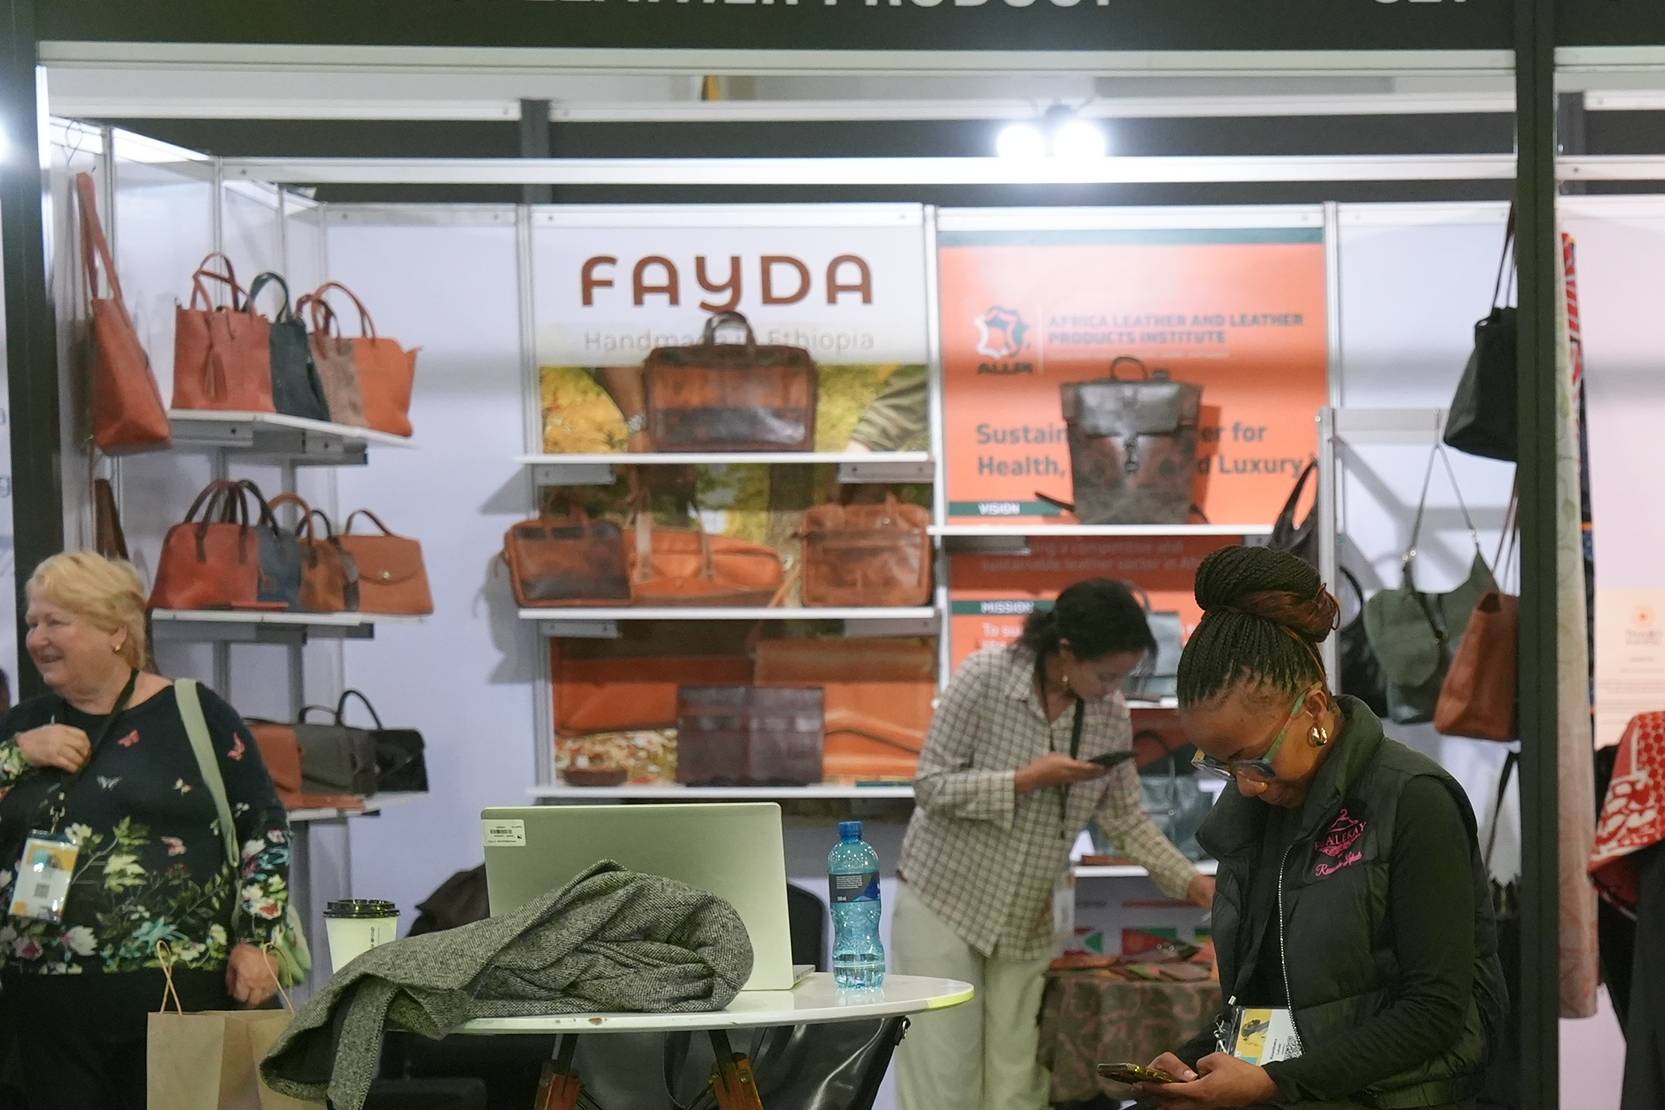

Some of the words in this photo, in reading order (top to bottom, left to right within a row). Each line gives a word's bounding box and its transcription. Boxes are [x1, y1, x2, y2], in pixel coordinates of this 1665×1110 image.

[580, 254, 874, 313] FAYDA
[1049, 314, 1107, 328] AFRICA
[1112, 314, 1185, 328] LEATHER
[1191, 314, 1226, 327] AND
[1229, 313, 1304, 327] LEATHER
[584, 327, 727, 350] Handmae
[768, 327, 875, 355] Ethiopia
[1049, 331, 1136, 344] PRODUCTS
[1140, 331, 1226, 343] INSTITUTE
[1232, 421, 1267, 442] for
[978, 455, 1066, 479] Health,
[1219, 454, 1302, 480] Luxury
[978, 502, 1020, 515] VISION
[981, 601, 1034, 614] MISSION
